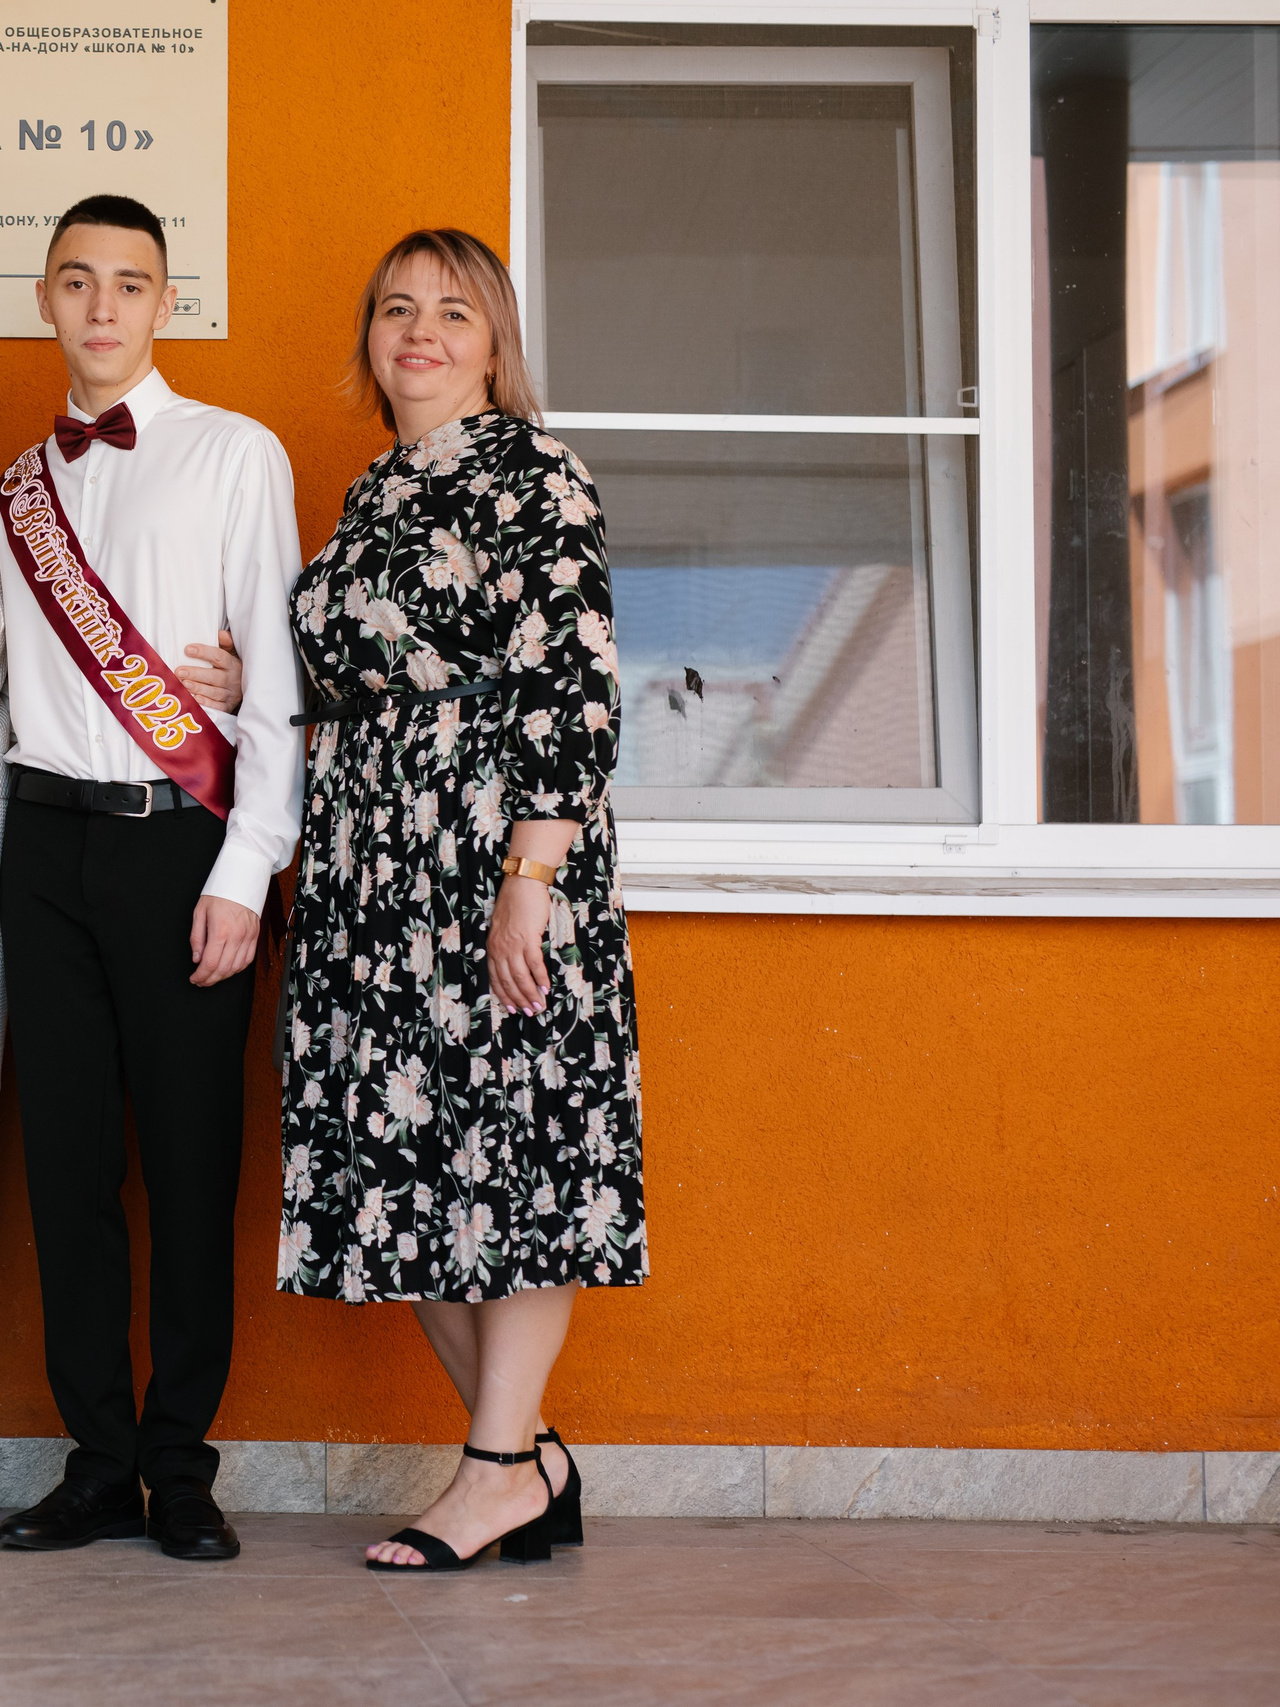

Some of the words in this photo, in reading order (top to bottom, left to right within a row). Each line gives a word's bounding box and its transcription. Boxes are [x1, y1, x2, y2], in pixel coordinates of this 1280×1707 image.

[4, 26, 203, 40] ОБЩЕОБРАЗОВАТЕЛЬНОЕ
[83, 42, 147, 54] «ШКОЛА
[151, 42, 166, 54] №
[170, 43, 195, 54] 10»
[18, 119, 63, 152] №
[80, 119, 154, 152] 10»
[172, 216, 186, 228] 11
[9, 478, 124, 668] Выпускник
[101, 654, 203, 750] 2025
